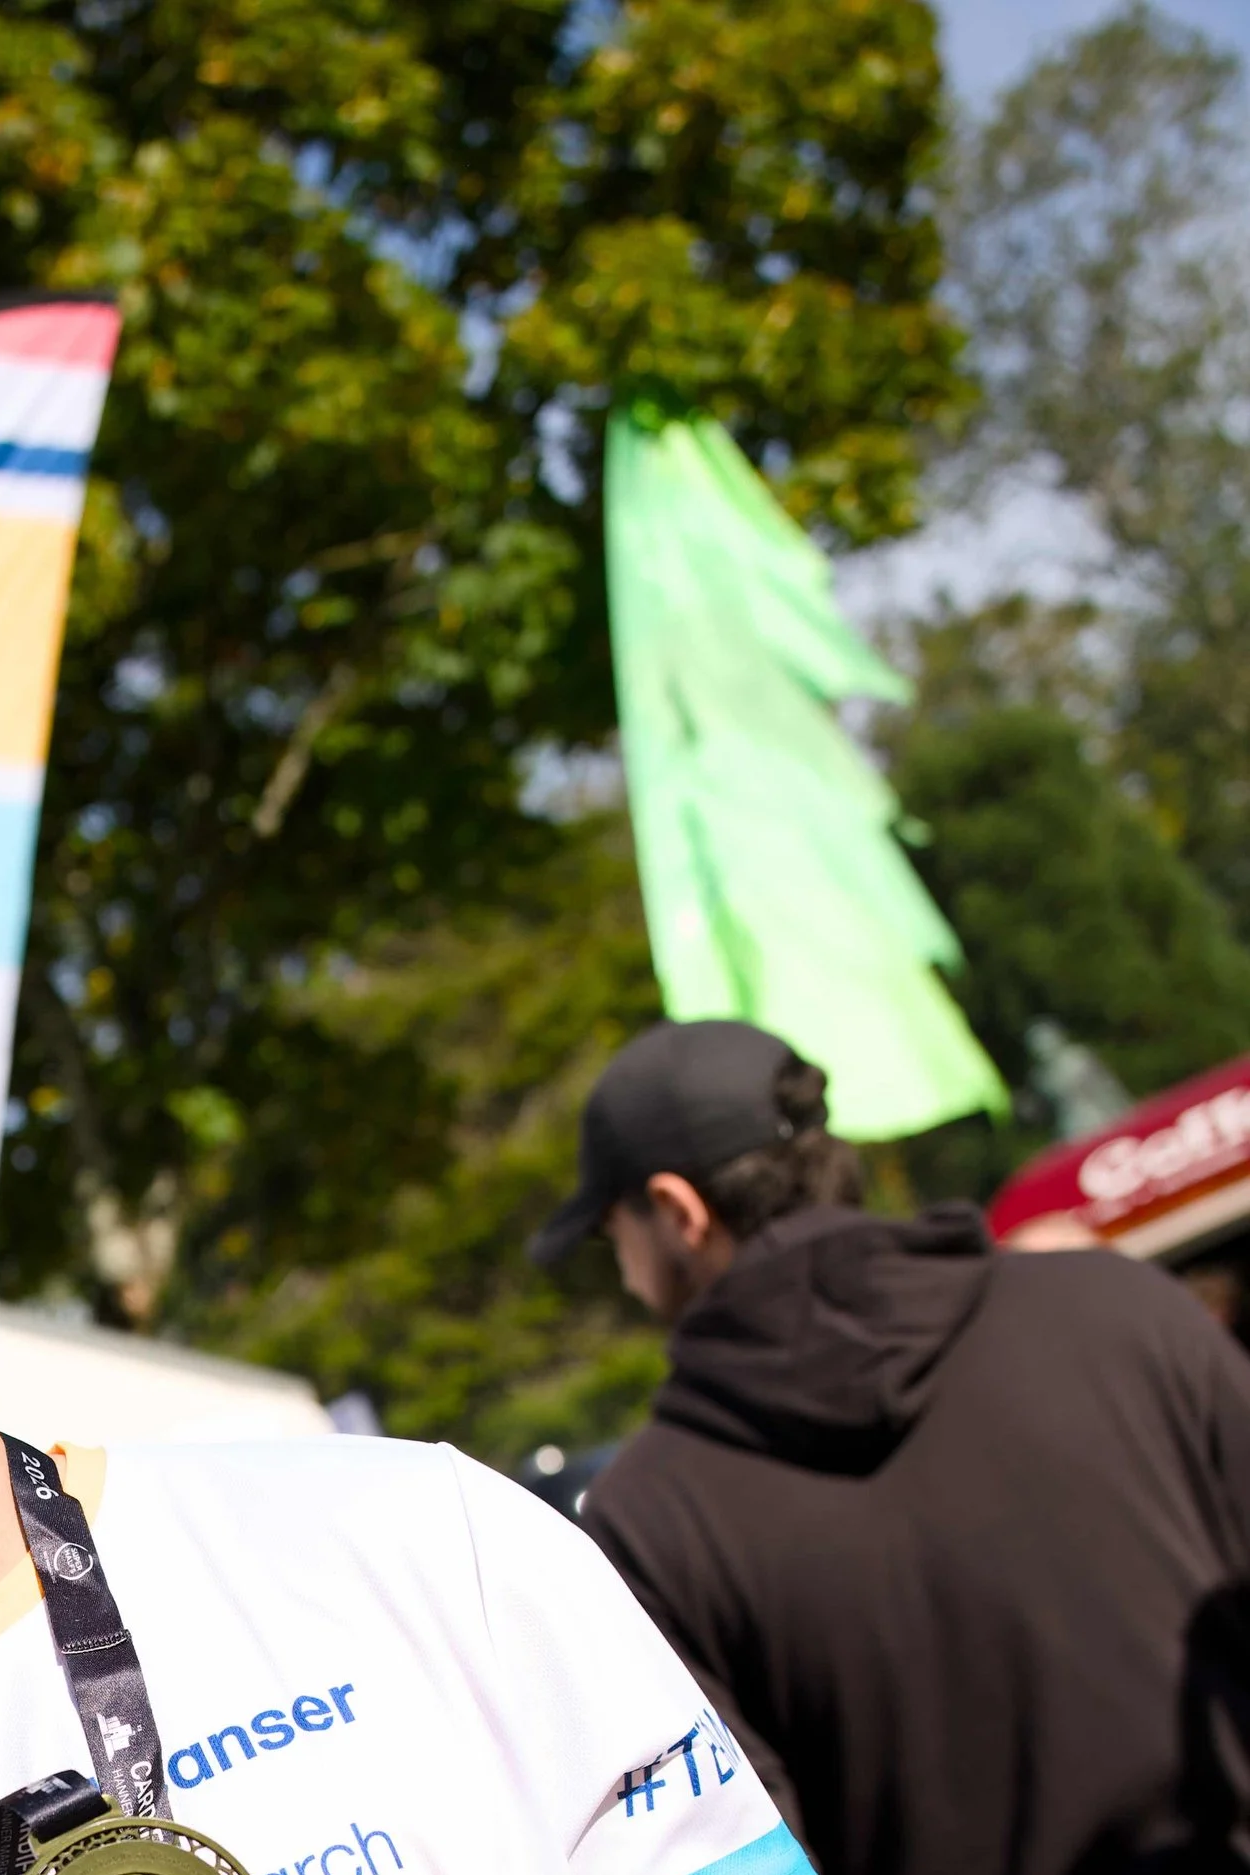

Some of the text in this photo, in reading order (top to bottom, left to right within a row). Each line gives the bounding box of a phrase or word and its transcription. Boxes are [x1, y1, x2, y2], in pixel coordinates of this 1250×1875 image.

[21, 1451, 60, 1501] 2026
[167, 1683, 356, 1789] anser
[111, 1769, 135, 1818] HANNER
[131, 1760, 157, 1820] CARD
